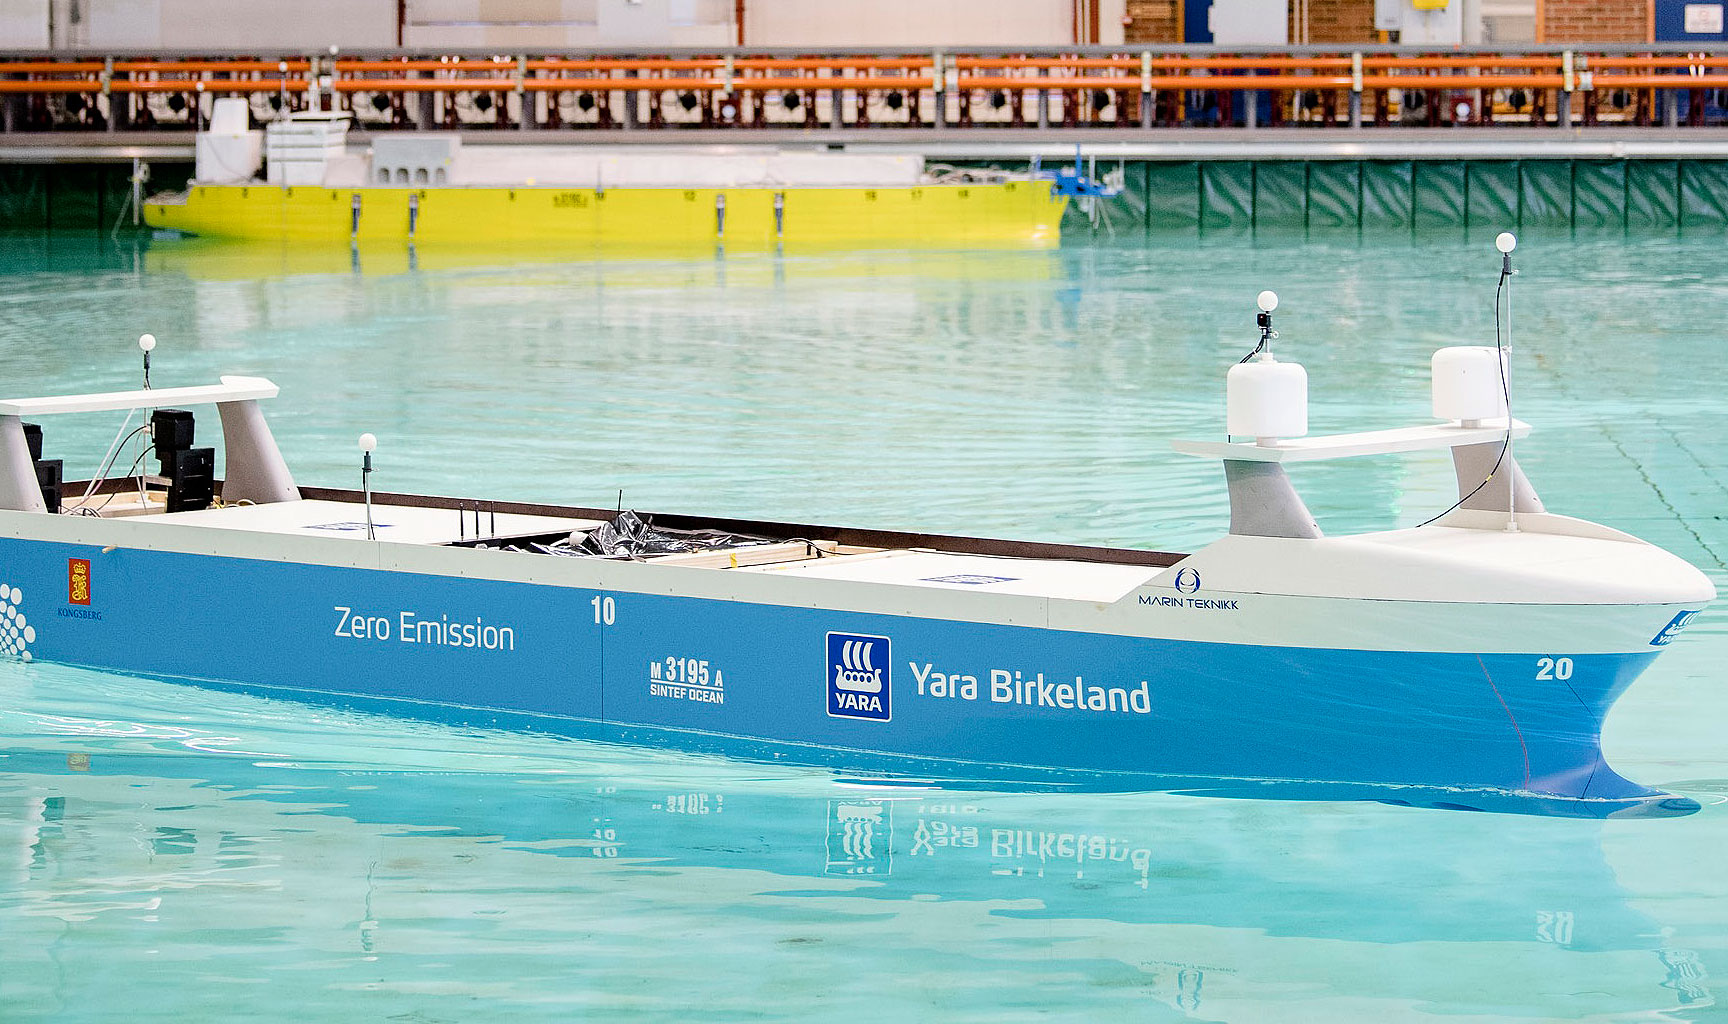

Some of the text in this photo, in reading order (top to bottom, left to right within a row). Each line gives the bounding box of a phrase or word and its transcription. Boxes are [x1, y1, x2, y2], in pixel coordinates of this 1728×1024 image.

[57, 607, 102, 621] KONGSBERG
[591, 595, 616, 626] 10
[1138, 595, 1239, 610] MARIN TEKNIKK
[334, 606, 514, 651] Zero Emission
[650, 656, 724, 687] M 3195 A
[1535, 657, 1574, 681] 20
[650, 684, 724, 704] SINTEF OCEAN
[909, 662, 1151, 714] Yara Birkeland
[835, 692, 883, 713] YARA
